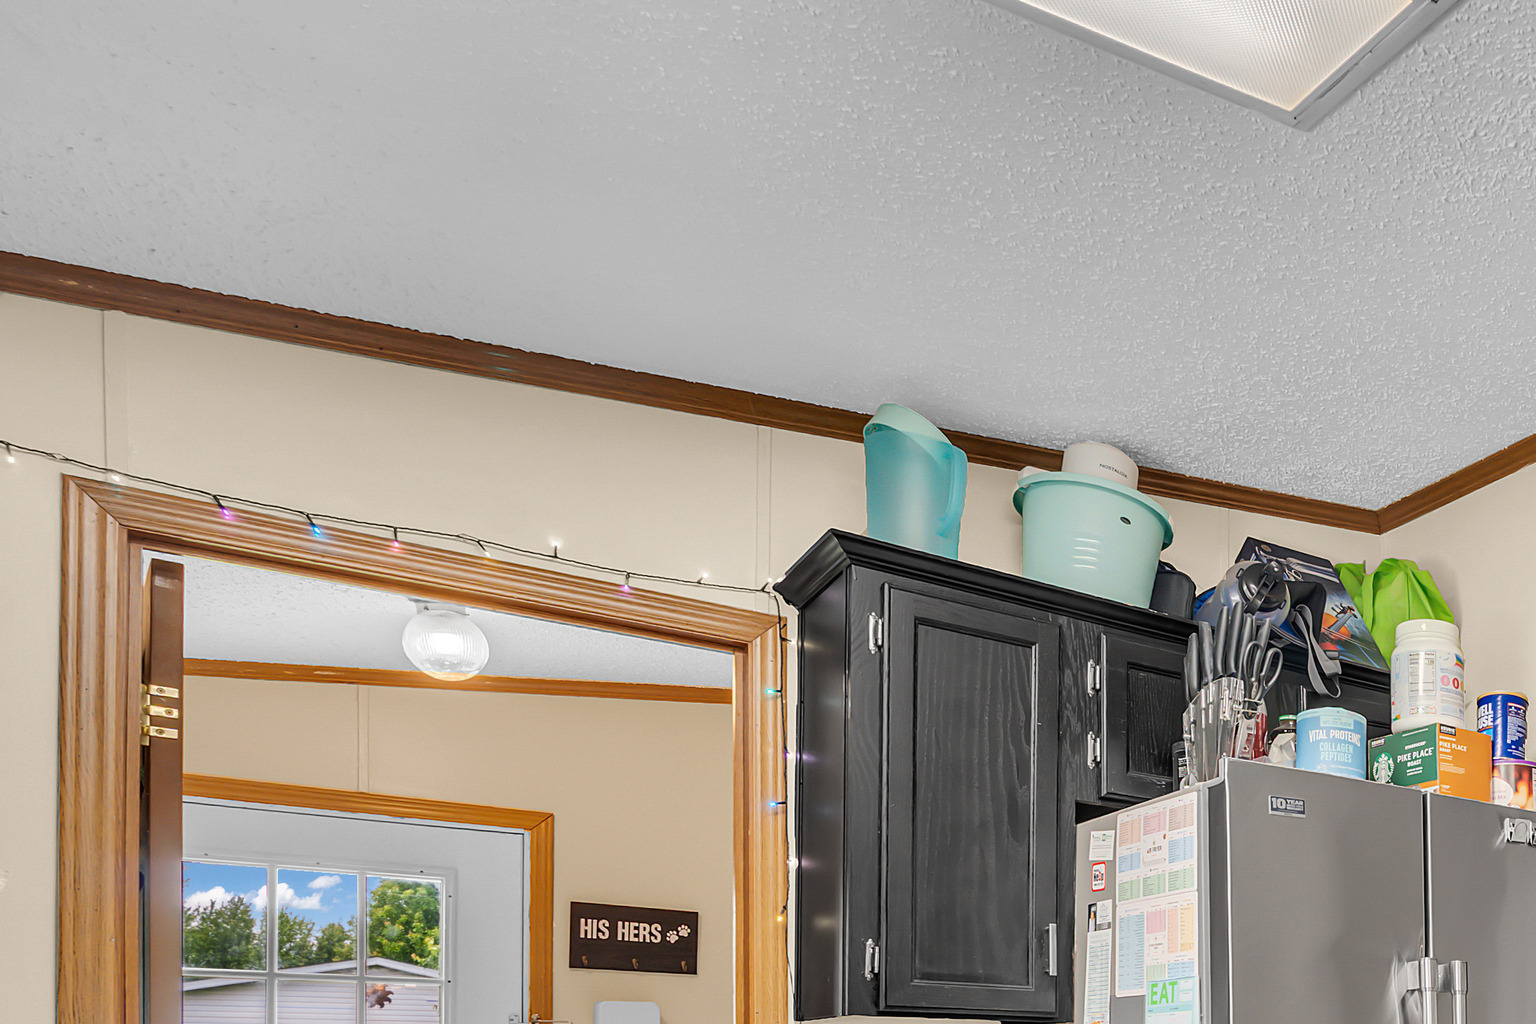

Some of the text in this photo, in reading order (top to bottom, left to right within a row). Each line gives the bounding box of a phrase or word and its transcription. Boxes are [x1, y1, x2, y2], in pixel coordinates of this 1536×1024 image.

[1099, 463, 1128, 479] NOSTALGIA
[1308, 729, 1361, 747] VITAL PROTEINS
[1439, 740, 1467, 752] PIKE PLACE
[1319, 741, 1354, 754] COLLAGEN
[1396, 752, 1412, 764] PIKE
[1412, 747, 1433, 760] PLACE
[1320, 751, 1352, 763] PEPTIDES
[1271, 797, 1286, 810] 10
[579, 918, 662, 944] HIS HERS
[1150, 980, 1178, 1006] EAT
